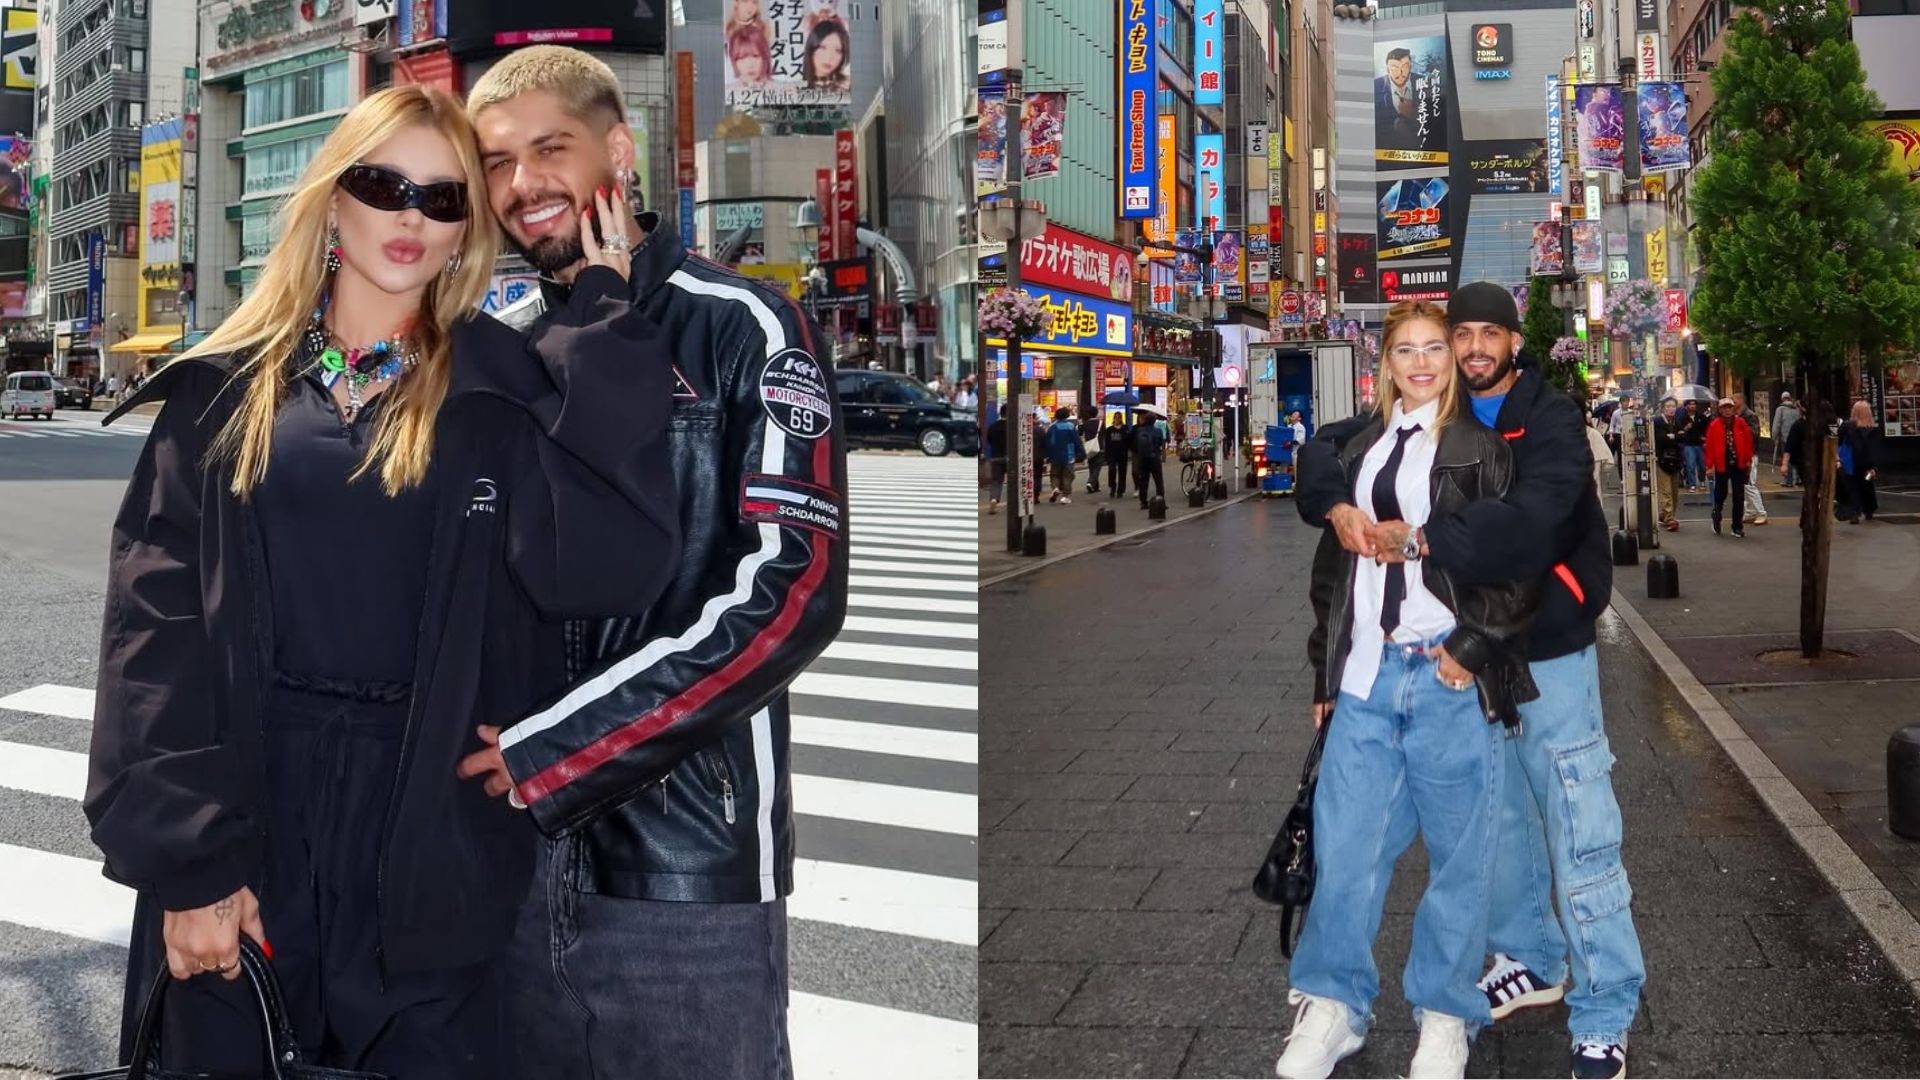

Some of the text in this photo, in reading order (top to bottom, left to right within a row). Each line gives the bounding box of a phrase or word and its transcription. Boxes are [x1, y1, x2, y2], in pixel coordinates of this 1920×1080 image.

[1476, 69, 1511, 79] IMAX
[1130, 89, 1146, 174] Tax Free Shop
[1396, 207, 1440, 226] コナン
[1020, 238, 1111, 287] カラオケ歌広場
[1402, 271, 1448, 285] MARUHAN
[1668, 301, 1681, 327] 焼肉
[766, 387, 830, 416] MOTORCYCLES
[790, 407, 815, 433] 69
[778, 505, 839, 531] SCHDARROW
